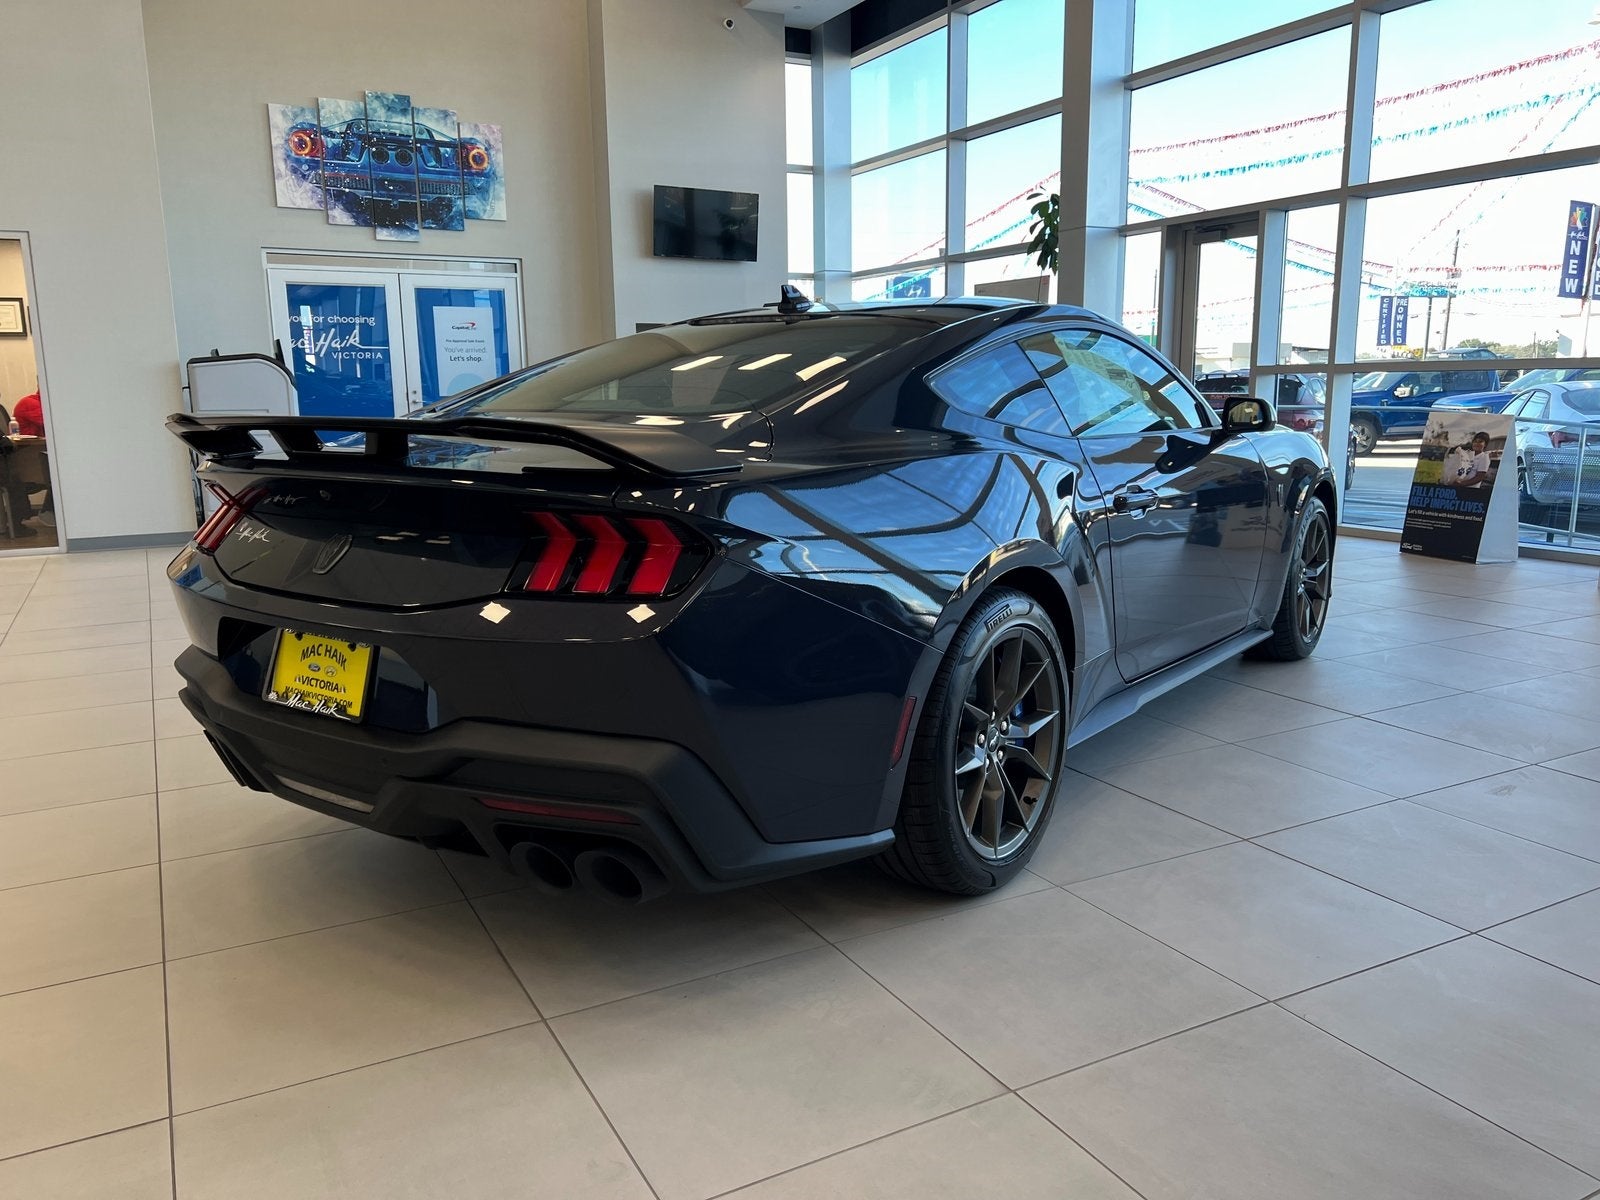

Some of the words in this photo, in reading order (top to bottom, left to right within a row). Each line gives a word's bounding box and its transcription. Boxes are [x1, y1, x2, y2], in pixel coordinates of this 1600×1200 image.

[1565, 240, 1581, 293] NEW
[327, 315, 376, 326] choosing
[1380, 298, 1389, 344] CERTIFIED
[1396, 307, 1404, 344] OWNED
[315, 328, 388, 357] Haik
[332, 351, 383, 359] VICTORIA
[1410, 496, 1430, 508] HELP
[1430, 497, 1460, 511] IMPACT
[1459, 500, 1486, 513] LIVES.
[1411, 486, 1427, 497] FILL
[1427, 488, 1433, 498] A
[1434, 488, 1457, 499] FORD.
[984, 603, 1013, 633] PIRELLI
[300, 643, 322, 662] MAC
[324, 644, 348, 672] HAIK
[301, 675, 339, 693] VICTORIA
[311, 700, 351, 720] Haik
